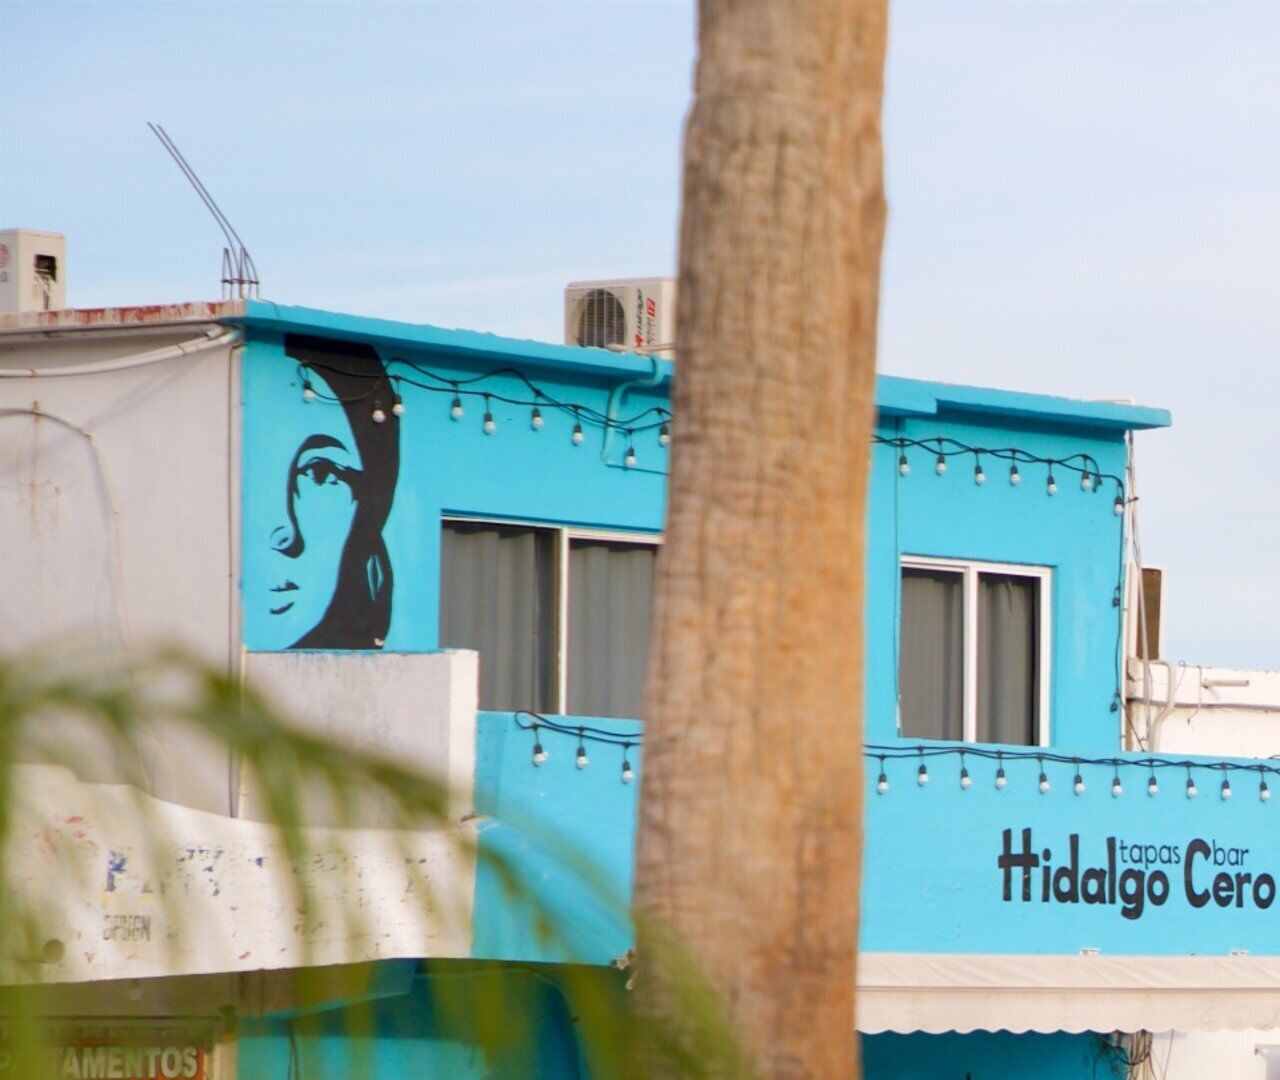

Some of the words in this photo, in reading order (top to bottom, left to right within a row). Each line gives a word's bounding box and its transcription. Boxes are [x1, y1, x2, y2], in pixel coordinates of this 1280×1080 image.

[998, 828, 1170, 920] Hidalgo
[1184, 838, 1277, 910] Cero
[1120, 838, 1181, 868] tapas
[1213, 838, 1249, 867] bar
